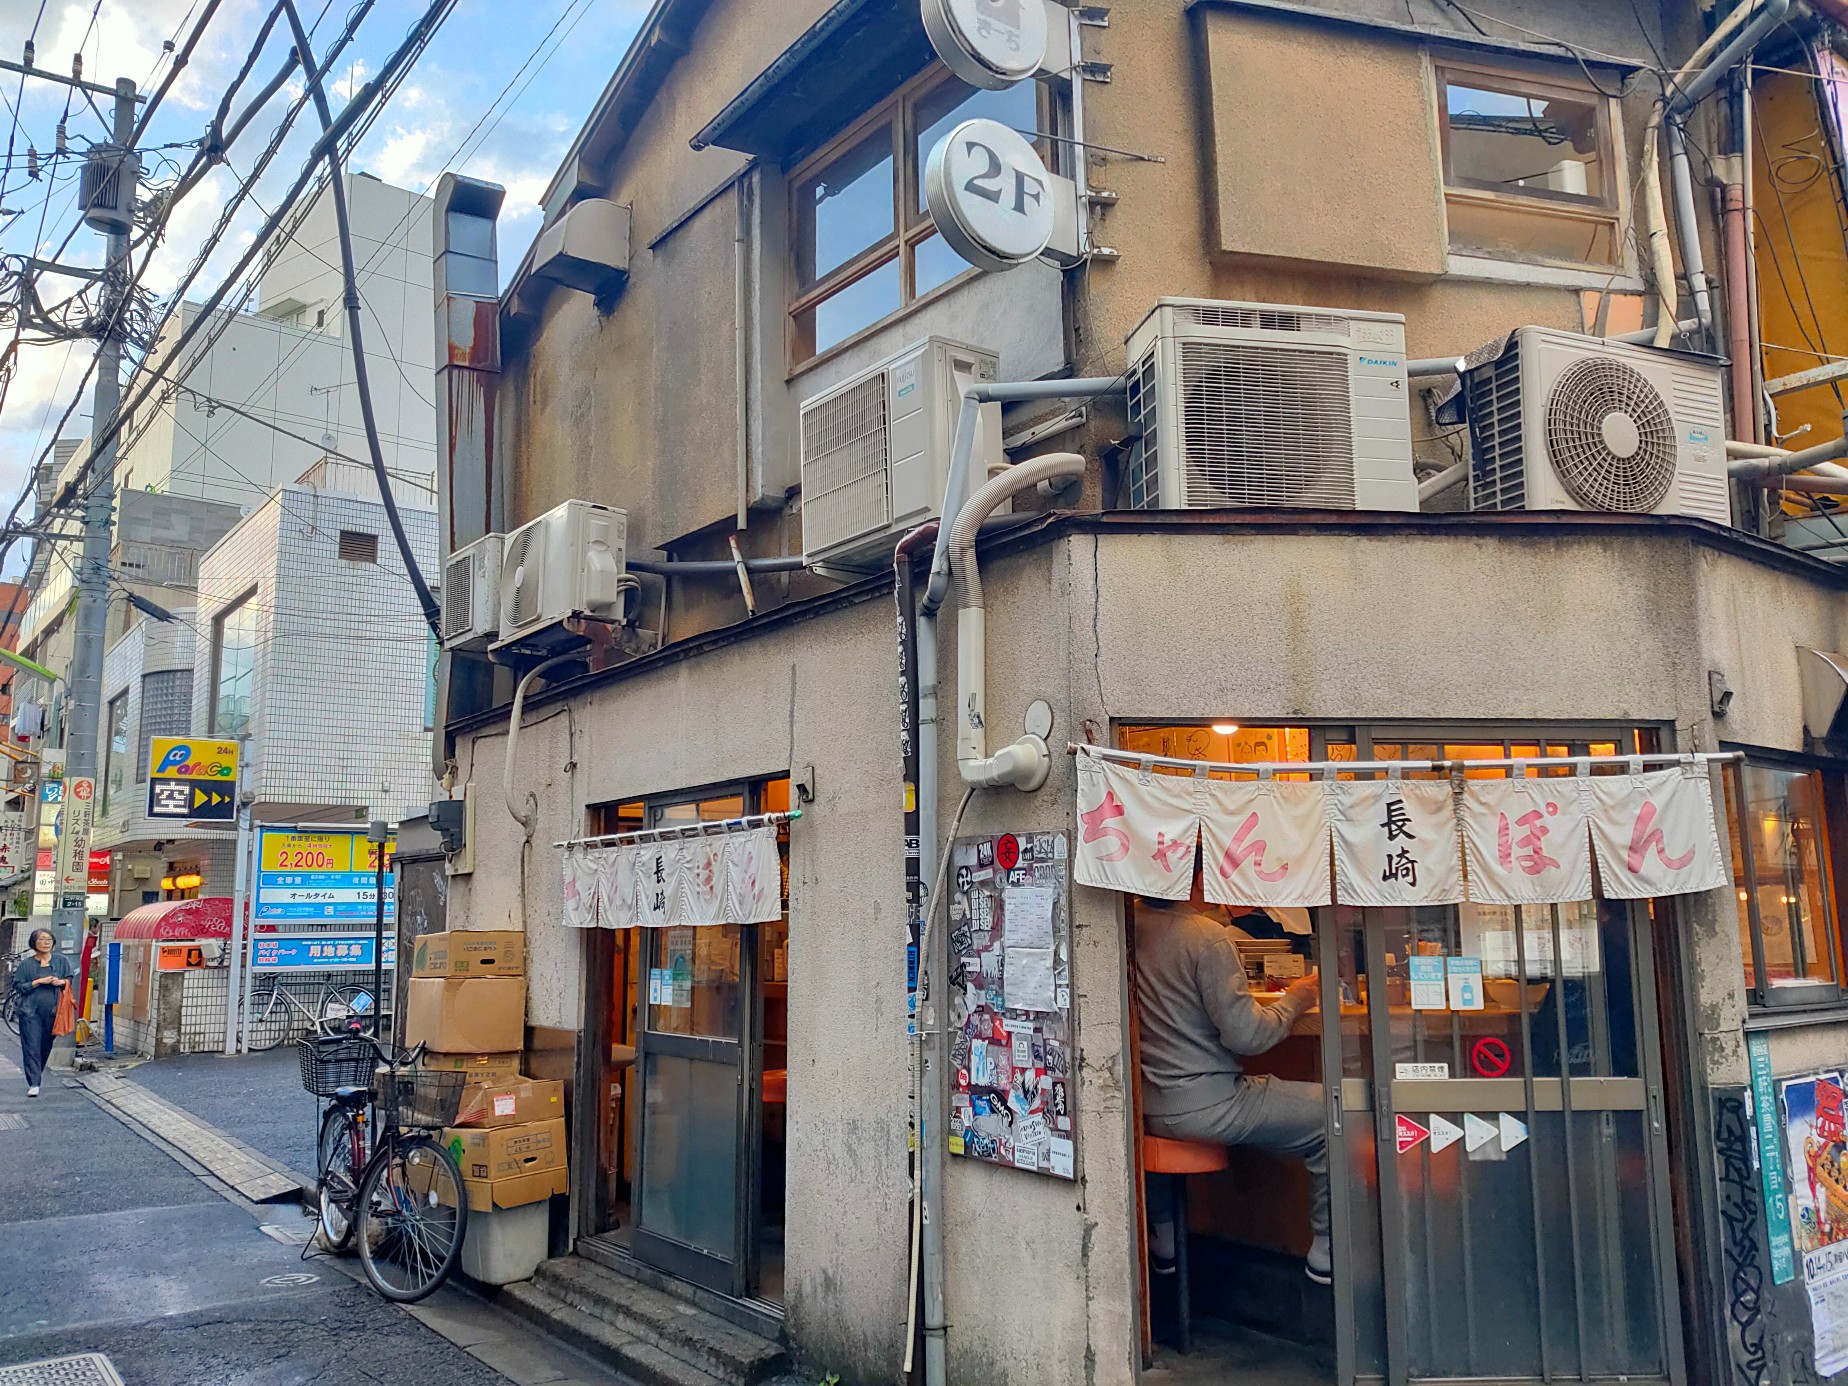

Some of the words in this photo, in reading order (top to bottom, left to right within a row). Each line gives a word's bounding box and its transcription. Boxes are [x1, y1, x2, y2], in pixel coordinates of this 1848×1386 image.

[964, 141, 1046, 217] 2F
[1367, 359, 1398, 367] DAIKIN
[216, 746, 234, 755] 24H
[153, 781, 190, 814] 空
[1379, 798, 1418, 888] 長崎
[278, 850, 334, 869] 2,200円
[290, 892, 335, 900] オールタイム
[356, 891, 376, 900] 15分
[652, 854, 667, 915] 長崎
